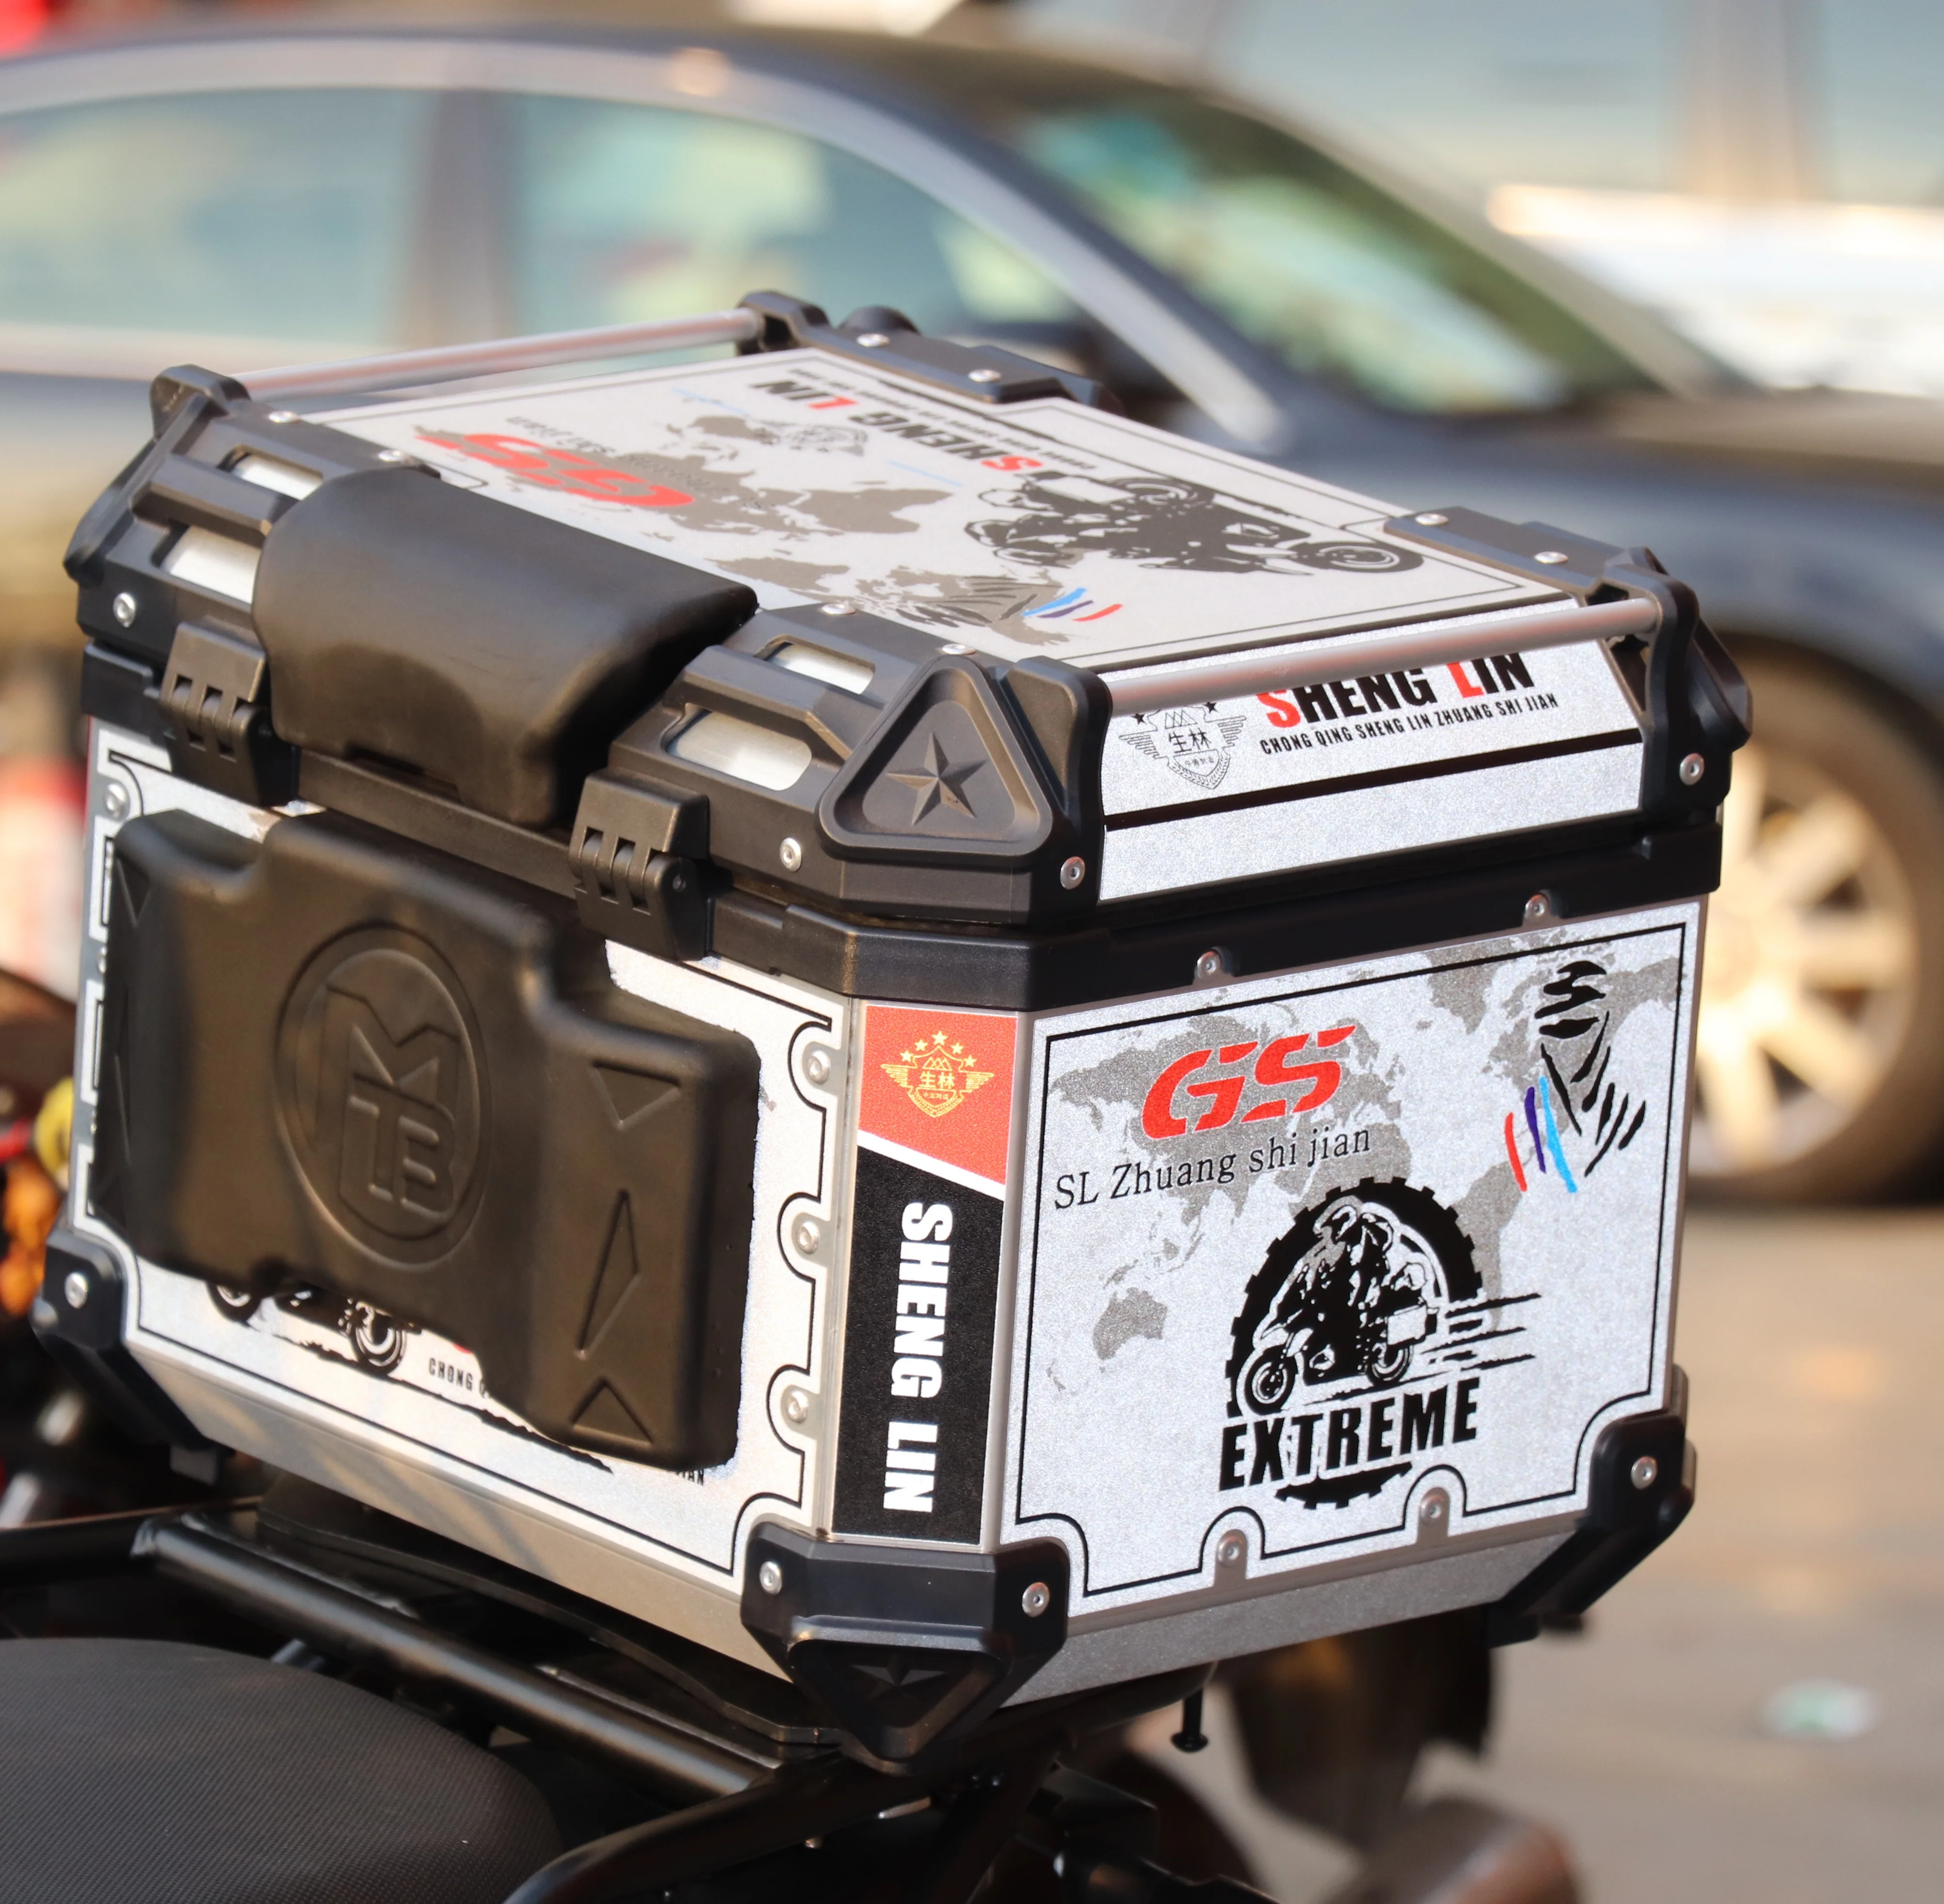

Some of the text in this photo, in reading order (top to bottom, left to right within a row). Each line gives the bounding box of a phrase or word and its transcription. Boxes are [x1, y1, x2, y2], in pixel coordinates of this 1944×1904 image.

[750, 380, 859, 410] LIN
[414, 433, 694, 507] GS
[849, 412, 1044, 471] SHENG
[1256, 652, 1534, 728] SHENG LIN
[1260, 691, 1558, 754] CHONG QING SHENG LIN ZHUANG SHI JIAN
[1168, 727, 1212, 753] 生林
[918, 1071, 955, 1090] 生林
[1142, 1025, 1356, 1139] GS
[1054, 1127, 1370, 1210] SL Zhuang shi jian
[429, 1357, 473, 1391] CHONG
[883, 1202, 954, 1513] SHENG LIN
[1219, 1377, 1480, 1492] EXTREME
